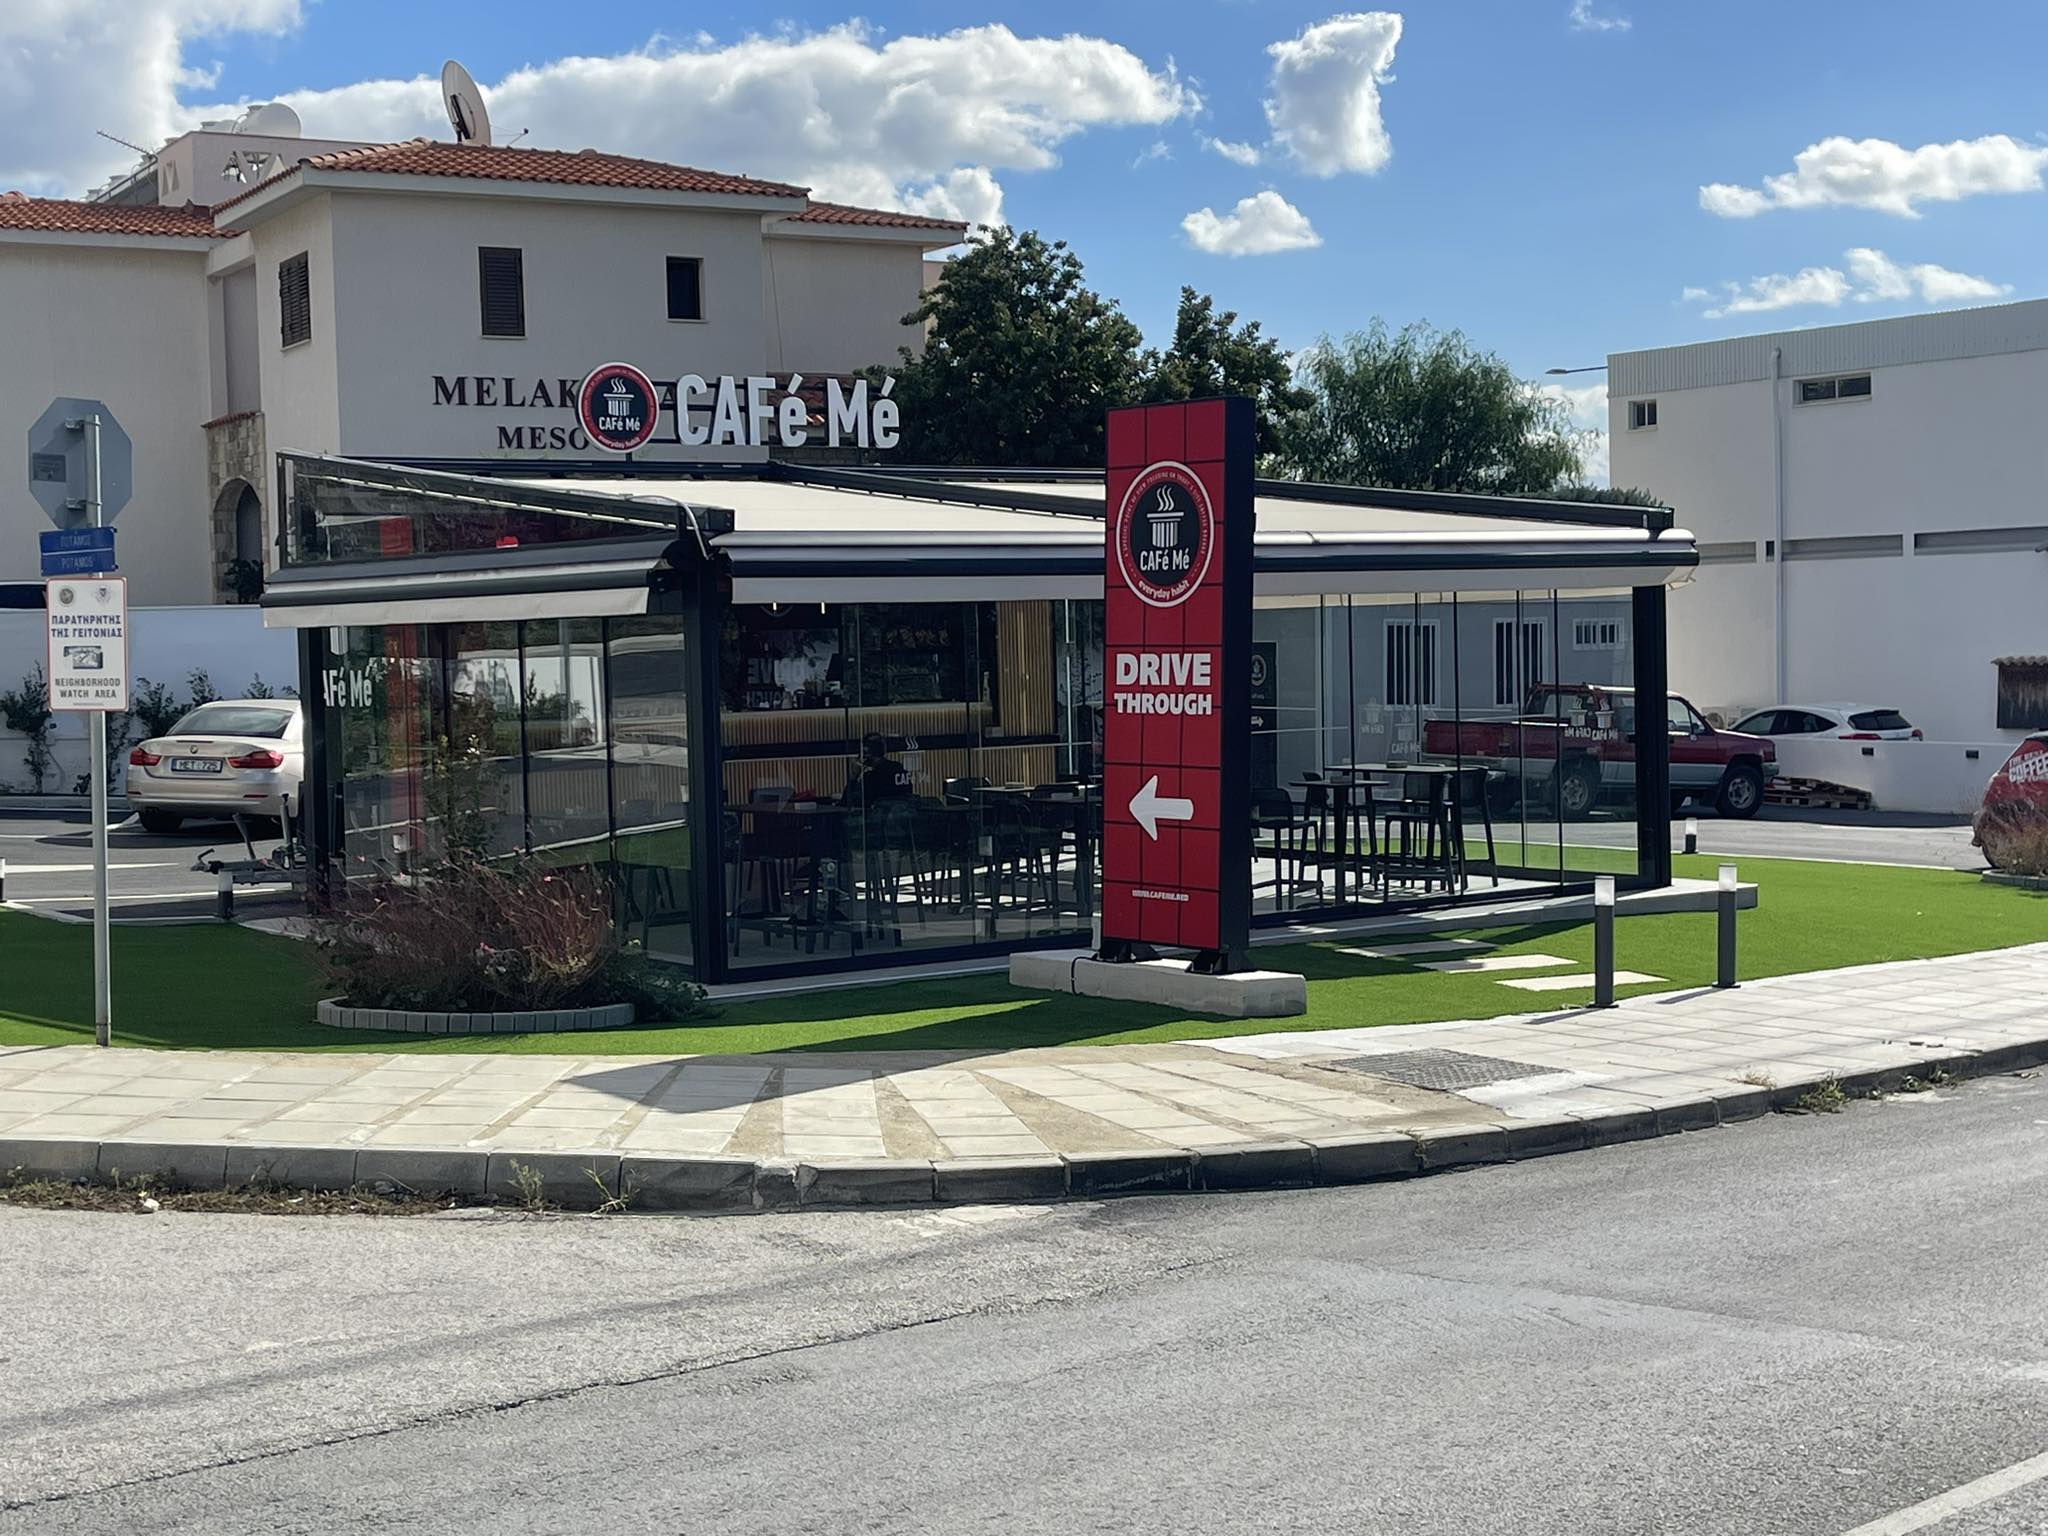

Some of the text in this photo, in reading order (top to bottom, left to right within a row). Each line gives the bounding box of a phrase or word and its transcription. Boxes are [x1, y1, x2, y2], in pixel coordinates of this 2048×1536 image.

[676, 373, 808, 448] CAFé
[827, 375, 900, 449] Mé
[599, 416, 640, 431] CAFé Mé
[497, 426, 589, 450] MESO
[1140, 548, 1190, 571] CAFé Mé
[1138, 579, 1190, 600] everyday habit
[51, 615, 121, 625] ΠΑΡΑΤΗΡΗΤΗΣ
[51, 628, 123, 638] ΤΗΣ ΓΕΙΤΟΝΙΑΣ
[1116, 653, 1212, 686] DRIVE
[55, 678, 121, 687] NEIGHBORHOOD
[59, 689, 117, 698] WATCH AREA
[1114, 693, 1213, 715] THROUGH
